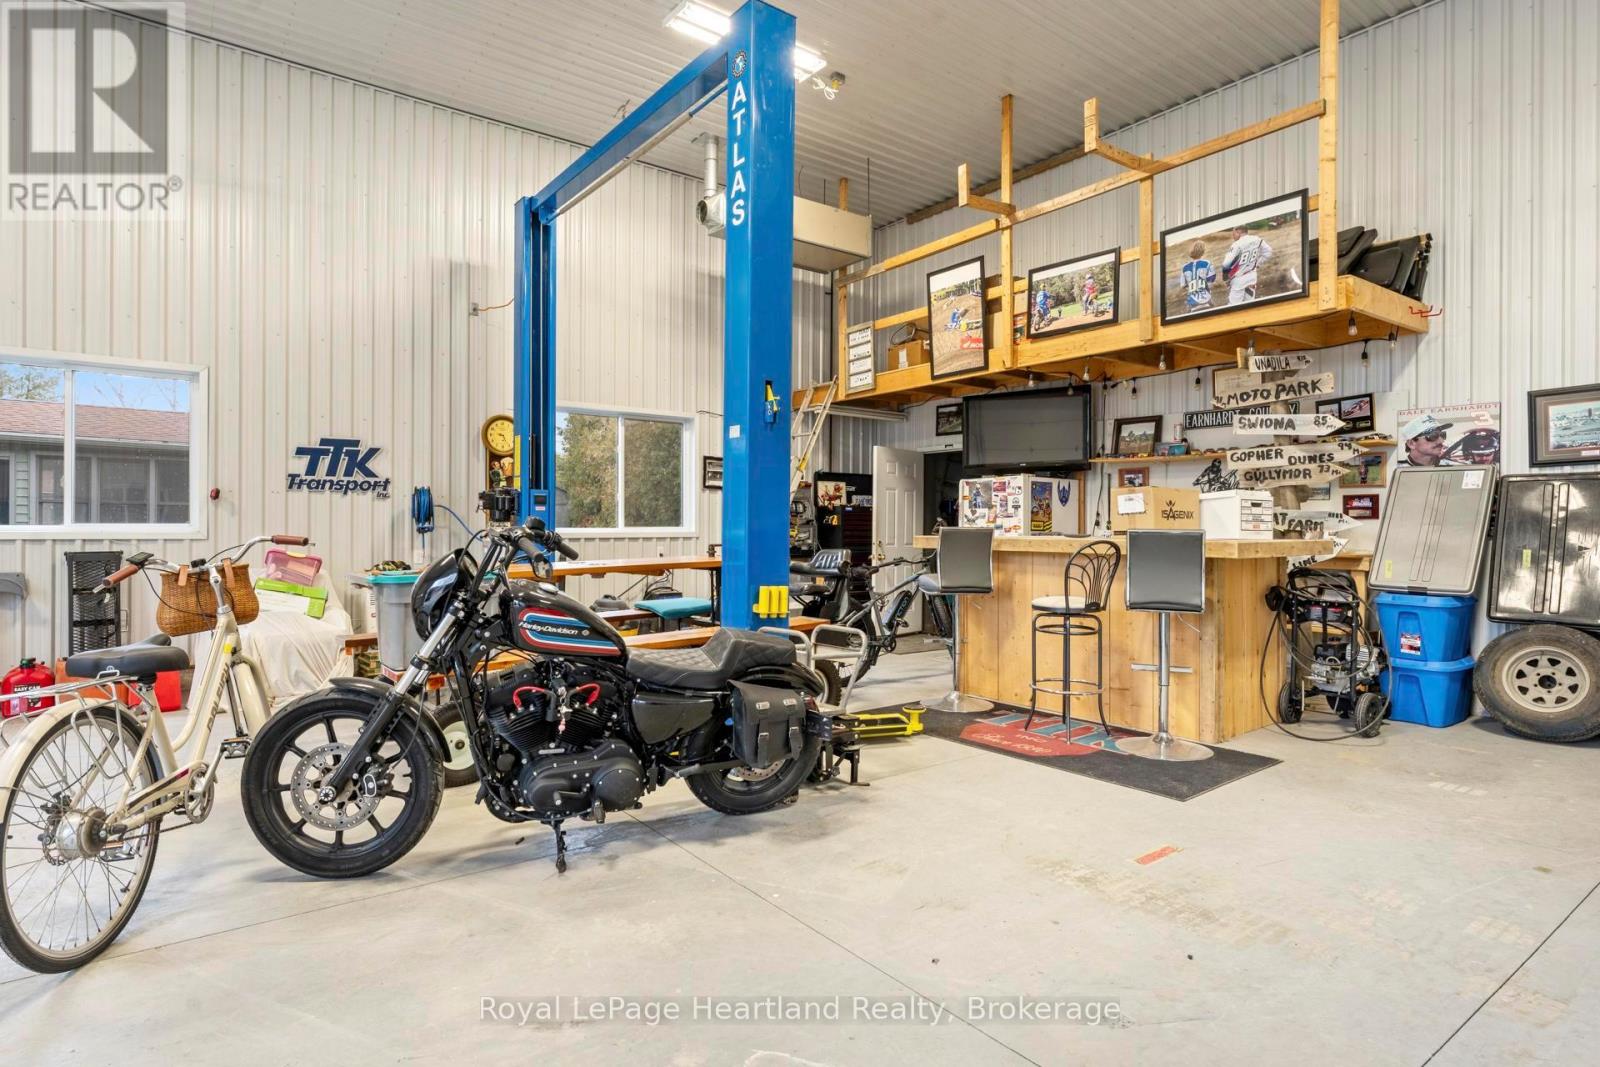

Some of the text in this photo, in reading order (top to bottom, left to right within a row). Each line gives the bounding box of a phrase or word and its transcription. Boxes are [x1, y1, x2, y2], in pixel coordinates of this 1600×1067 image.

[731, 80, 747, 227] ATLAS
[1226, 378, 1323, 406] MOTO PARK
[1238, 415, 1296, 431] SWIONA
[1313, 415, 1328, 427] 85
[294, 437, 382, 479] TTK
[1230, 447, 1284, 463] GOPHER
[1287, 452, 1335, 466] DUNES
[288, 473, 391, 496] Transport
[1244, 468, 1312, 484] GULLYMOR
[1161, 506, 1195, 521] ISAGENIX
[1288, 518, 1324, 532] FARM
